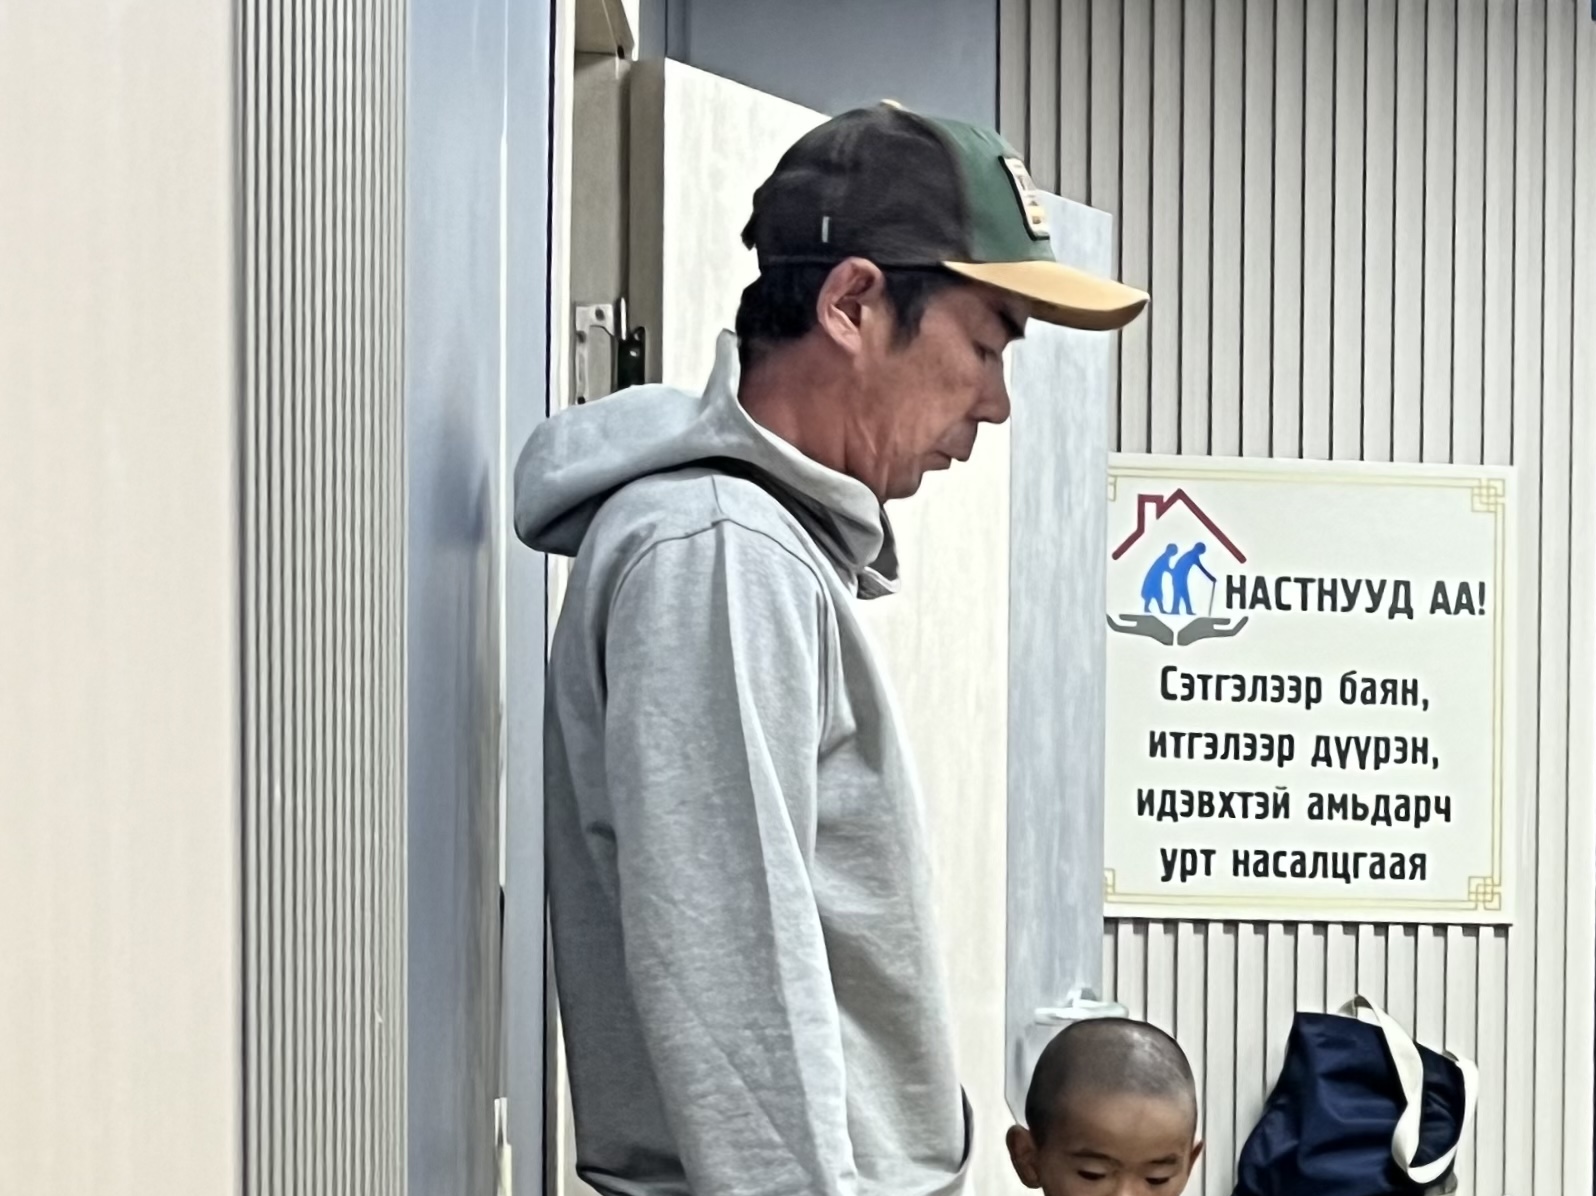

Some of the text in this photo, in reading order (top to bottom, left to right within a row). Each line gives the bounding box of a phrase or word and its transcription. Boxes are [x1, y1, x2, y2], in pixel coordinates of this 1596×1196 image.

[1225, 574, 1487, 620] НАСТНУУД АА!
[1160, 664, 1430, 711] Сэтгэлээр баян,
[1148, 729, 1440, 770] итгэлээр дүүрэн,
[1136, 785, 1452, 829] идэвхтэй амьдарч
[1159, 846, 1428, 884] урт насалцгаая
